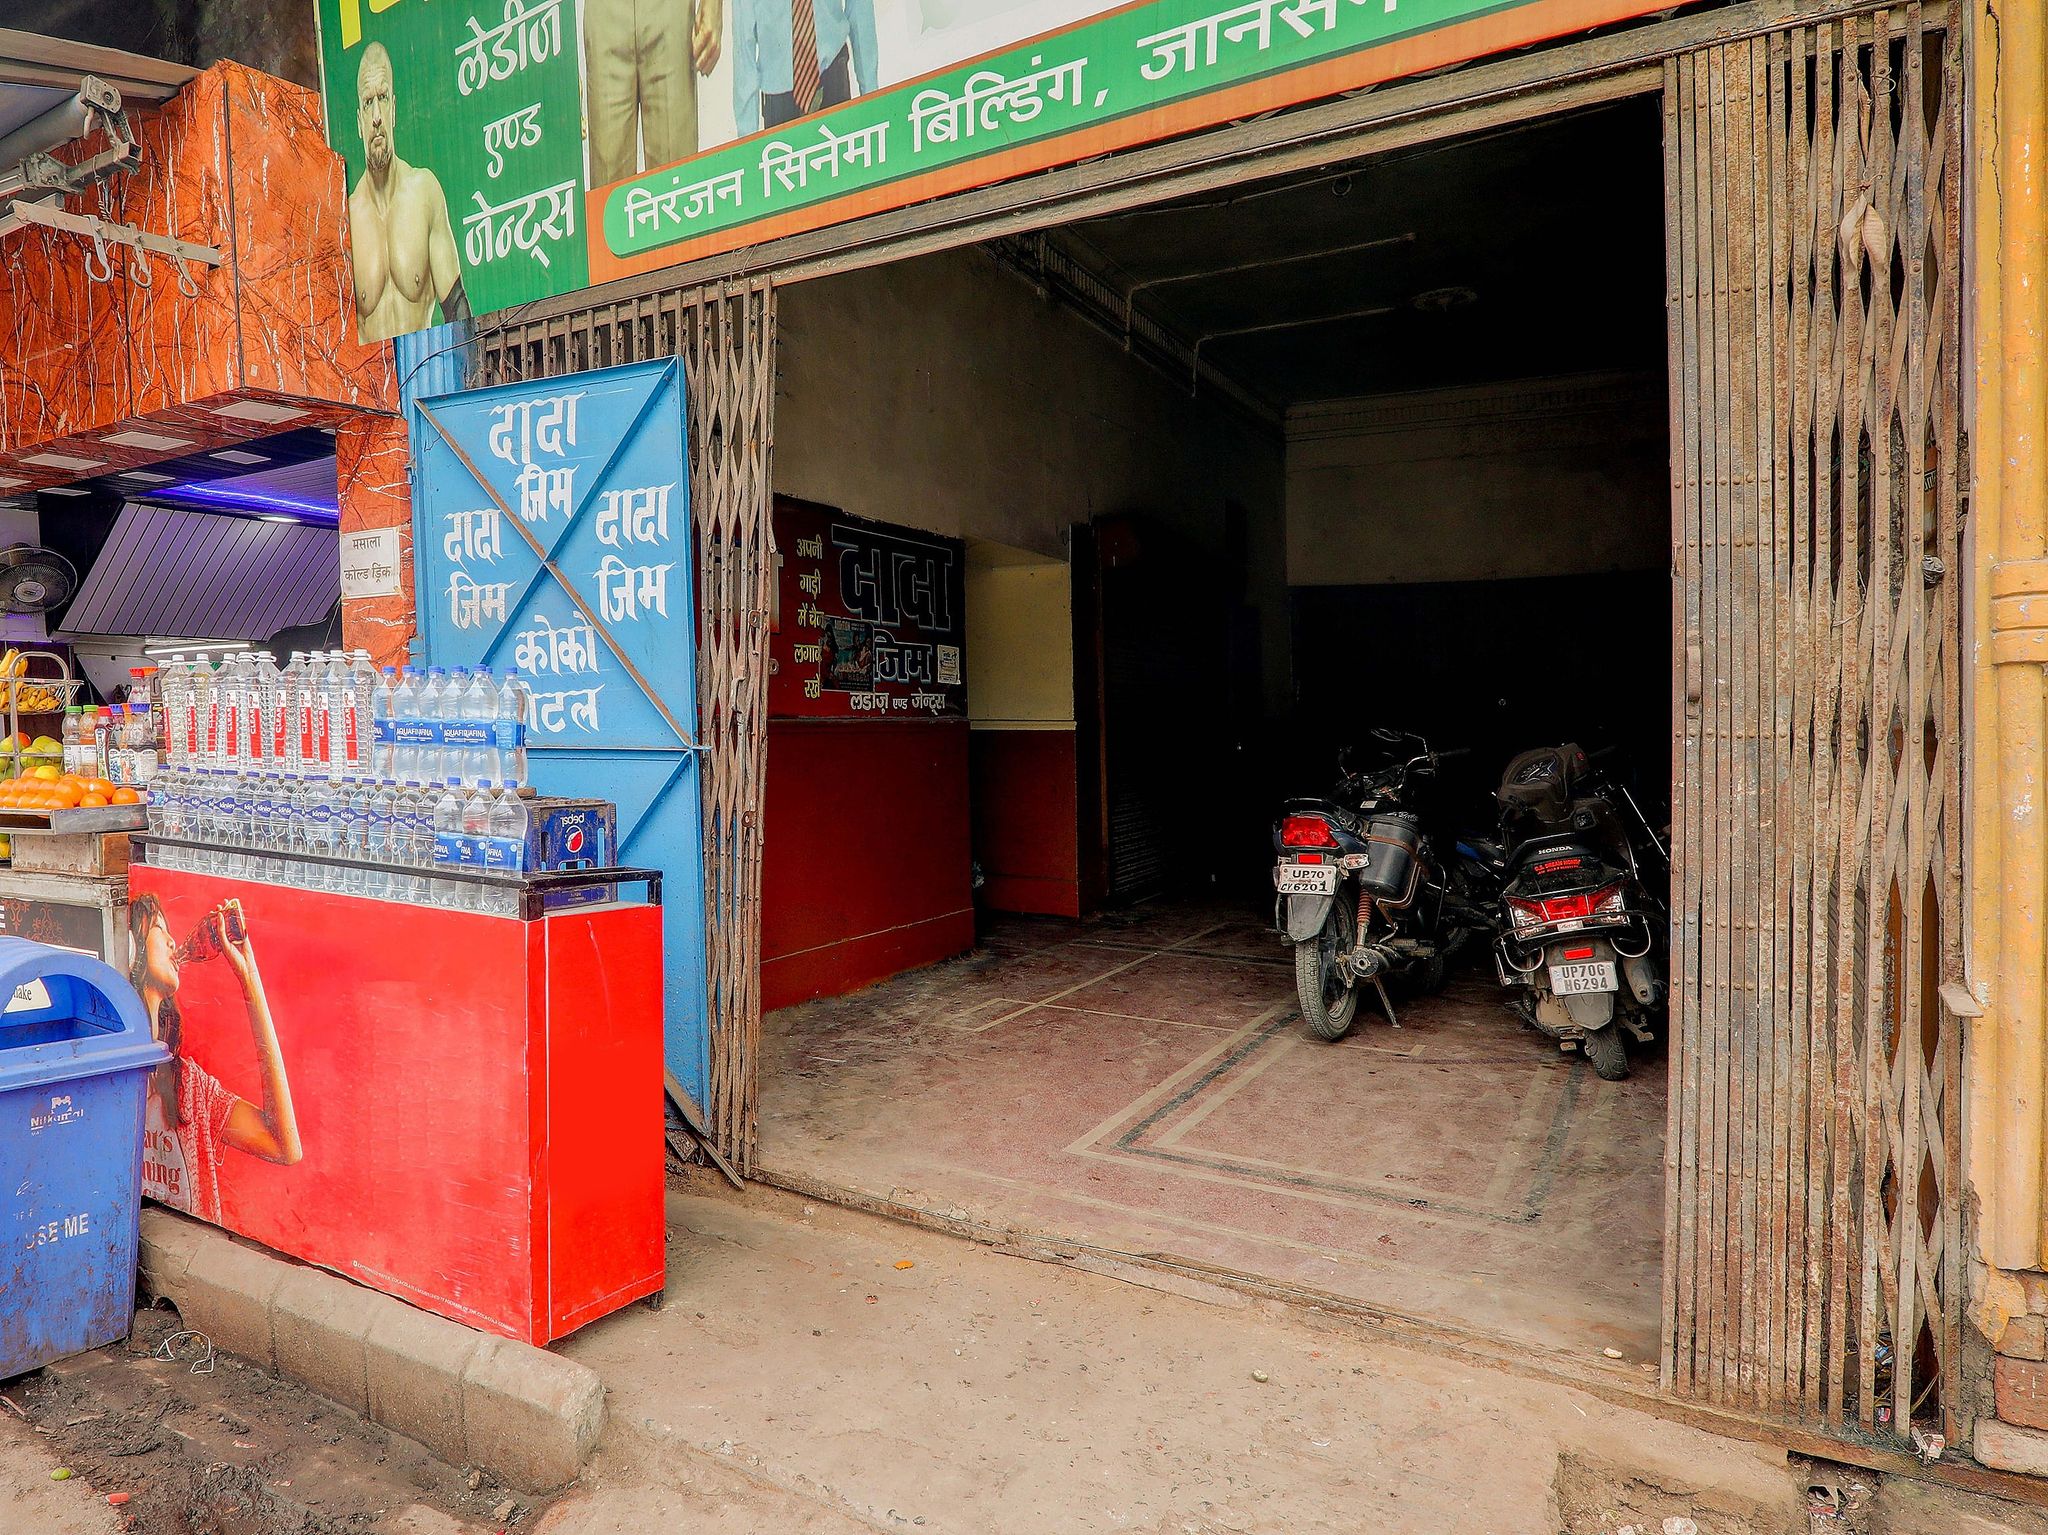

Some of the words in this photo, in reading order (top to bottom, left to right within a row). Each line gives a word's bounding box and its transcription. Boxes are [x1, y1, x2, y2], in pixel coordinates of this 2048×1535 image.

[483, 102, 542, 179] एण्ड
[624, 168, 745, 238] निरंजन
[759, 120, 890, 198] सिनेमा
[463, 179, 577, 269] जेन्ट्स
[489, 391, 589, 466] दादा
[513, 464, 580, 522] जिम
[595, 481, 677, 550] दादा
[352, 536, 381, 550] मसाला
[443, 508, 504, 572] दादा
[796, 534, 823, 560] अपनी
[344, 564, 370, 580] कोल्ड
[444, 571, 518, 630] जिम
[592, 555, 677, 626] जिम
[515, 610, 600, 677] कोको
[1538, 845, 1574, 855] HONDA
[1561, 964, 1605, 979] UP70G
[1564, 977, 1608, 991] H6294
[64, 1213, 89, 1238] ME
